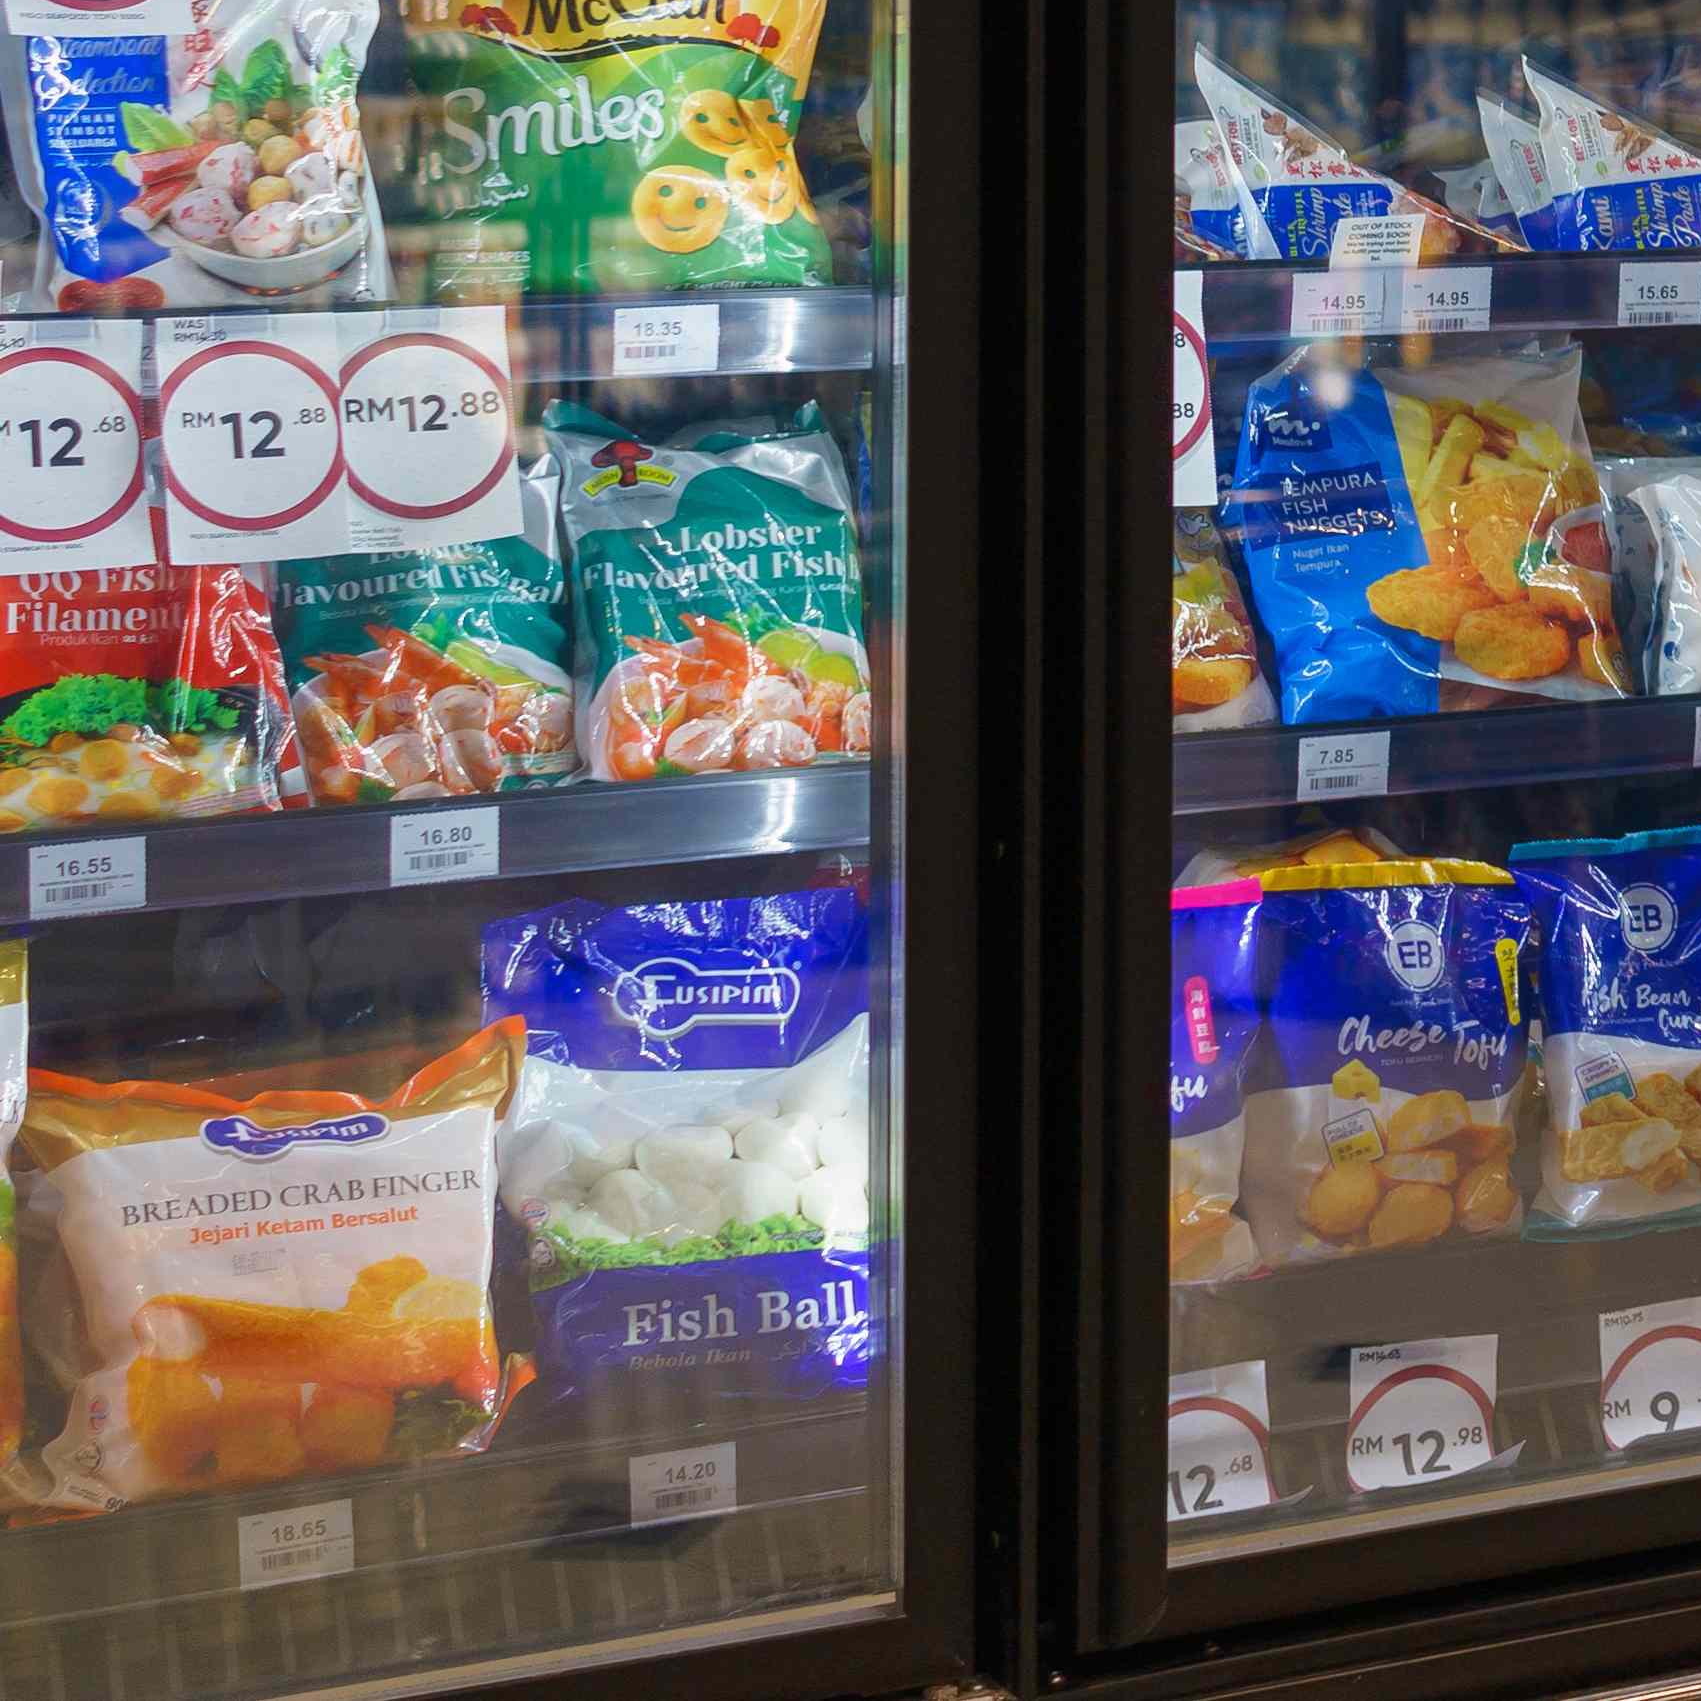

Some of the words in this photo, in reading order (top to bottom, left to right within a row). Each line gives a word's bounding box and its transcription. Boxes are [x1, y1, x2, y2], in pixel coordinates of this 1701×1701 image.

[441, 75, 667, 177] Smiles
[1301, 186, 1333, 258] Shrimp
[1351, 222, 1370, 231] OUT
[1384, 221, 1412, 230] STOCK
[1646, 181, 1678, 248] Shrimp
[1320, 295, 1366, 311] 14.95
[1426, 290, 1470, 308] 14.95
[1636, 284, 1679, 302] 15.65
[632, 321, 683, 339] 18.35
[18, 417, 86, 468] 12
[91, 415, 127, 434] .68
[182, 411, 216, 429] RM
[220, 411, 287, 460] 12
[292, 407, 328, 426] .88
[1279, 470, 1378, 498] TEMPURA
[1281, 496, 1328, 517] FISH
[678, 522, 823, 553] Lobster
[1286, 511, 1385, 536] NUGGETS
[583, 557, 759, 591] Flavoured
[771, 550, 848, 583] Fish
[6, 600, 185, 634] Filament
[1318, 747, 1354, 765] 7.85
[418, 825, 473, 846] 16.80
[54, 857, 113, 877] 16.55
[1628, 904, 1662, 933] EB
[1399, 939, 1434, 969] EB
[1635, 983, 1692, 1009] Bean
[1337, 1014, 1448, 1057] Cheese
[1452, 1019, 1508, 1070] Tofu
[120, 1188, 273, 1227] BREADED
[278, 1178, 363, 1207] CRAB
[372, 1168, 482, 1200] FINGER
[188, 1220, 251, 1246] Jejari
[255, 1214, 326, 1238] Ketam
[331, 1204, 418, 1229] Bersalut
[621, 1297, 739, 1348] Fish
[758, 1279, 857, 1333] Ball
[627, 1350, 700, 1372] Bebola
[705, 1346, 753, 1364] Ikan
[1601, 1399, 1632, 1421] RM
[1650, 1390, 1680, 1433] 9
[1350, 1436, 1382, 1457] RM
[1392, 1430, 1453, 1476] 12
[1452, 1426, 1483, 1449] .98
[664, 1460, 716, 1485] 14.20
[1169, 1464, 1224, 1515] 12
[1223, 1455, 1253, 1476] .68
[271, 1517, 327, 1544] 18.65
